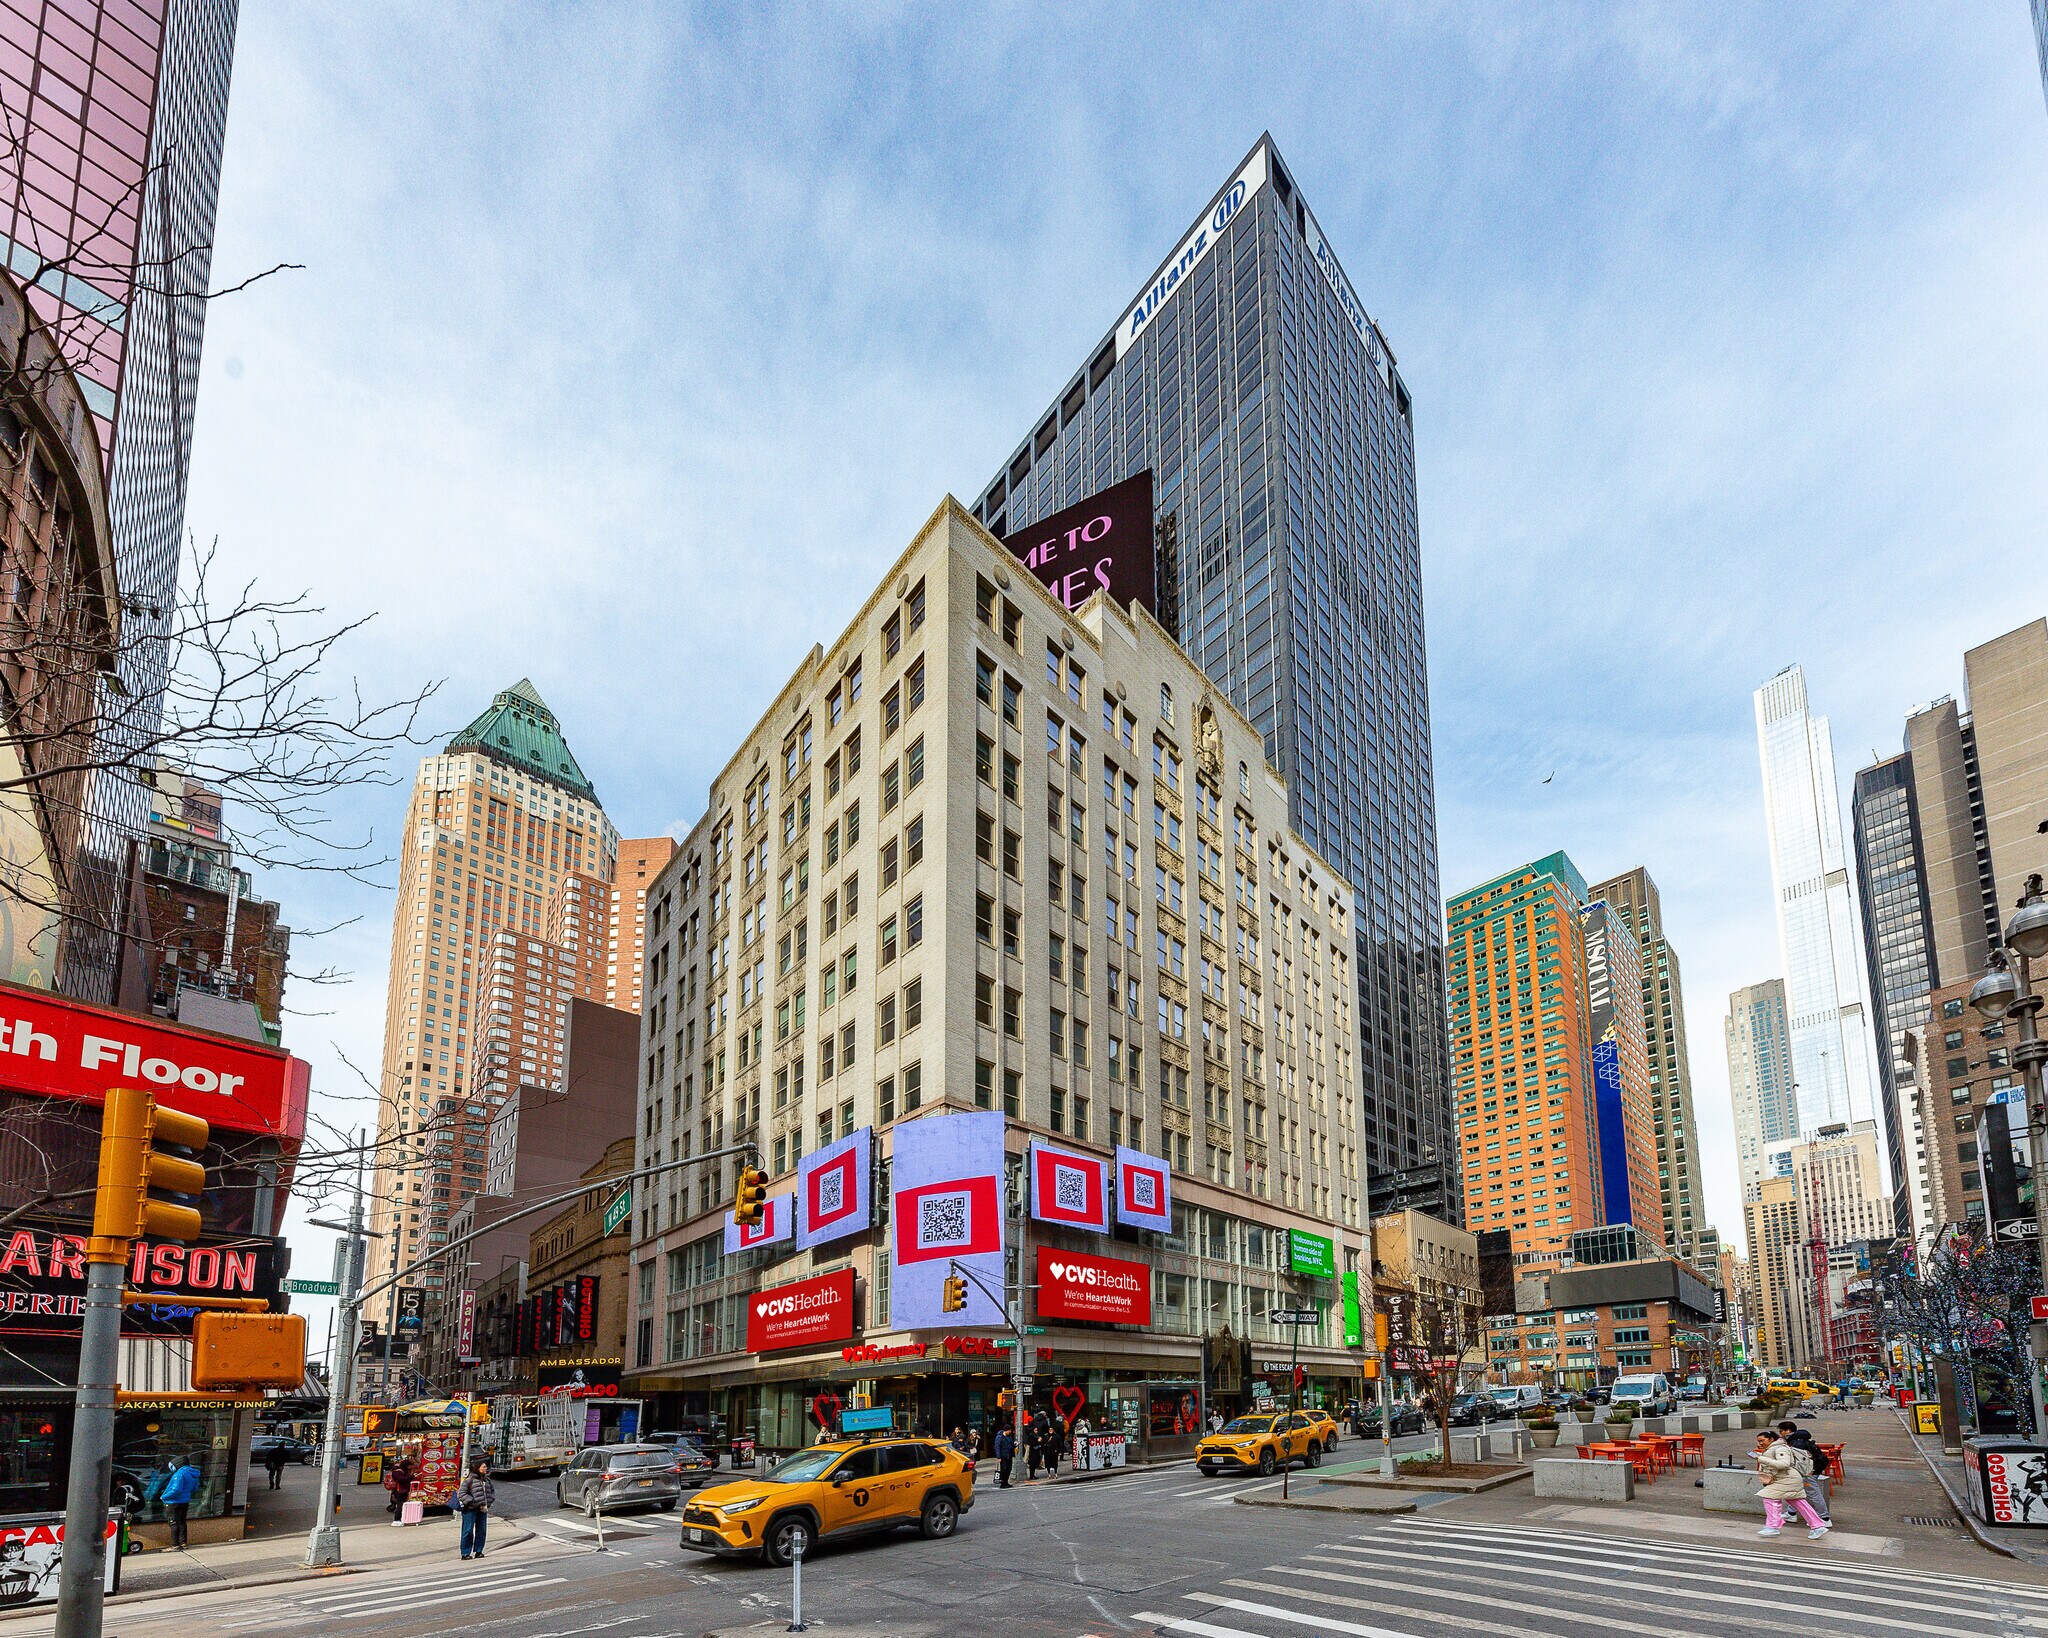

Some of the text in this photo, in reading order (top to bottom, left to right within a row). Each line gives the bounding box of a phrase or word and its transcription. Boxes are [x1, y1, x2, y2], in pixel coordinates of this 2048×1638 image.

[1130, 229, 1208, 338] Allianz
[1316, 238, 1363, 335] Allianz
[1063, 515, 1113, 552] TO
[1049, 557, 1113, 610] ES
[80, 1034, 245, 1096] Floor
[2009, 1223, 2039, 1235] ONE
[0, 1231, 258, 1292] ARISON
[292, 1281, 338, 1295] Broadway
[402, 1293, 419, 1309] 15
[462, 1294, 473, 1341] park
[579, 1277, 594, 1339] CHICAGO
[1345, 1335, 1358, 1344] TD
[539, 1357, 622, 1367] AMBASSADOR
[1269, 1363, 1278, 1371] THE
[183, 1401, 225, 1409] LUNCH
[234, 1400, 276, 1409] DINNER
[215, 1437, 225, 1446] A
[1089, 1435, 1126, 1447] CHICAGO
[1986, 1453, 2013, 1522] CHICAGO
